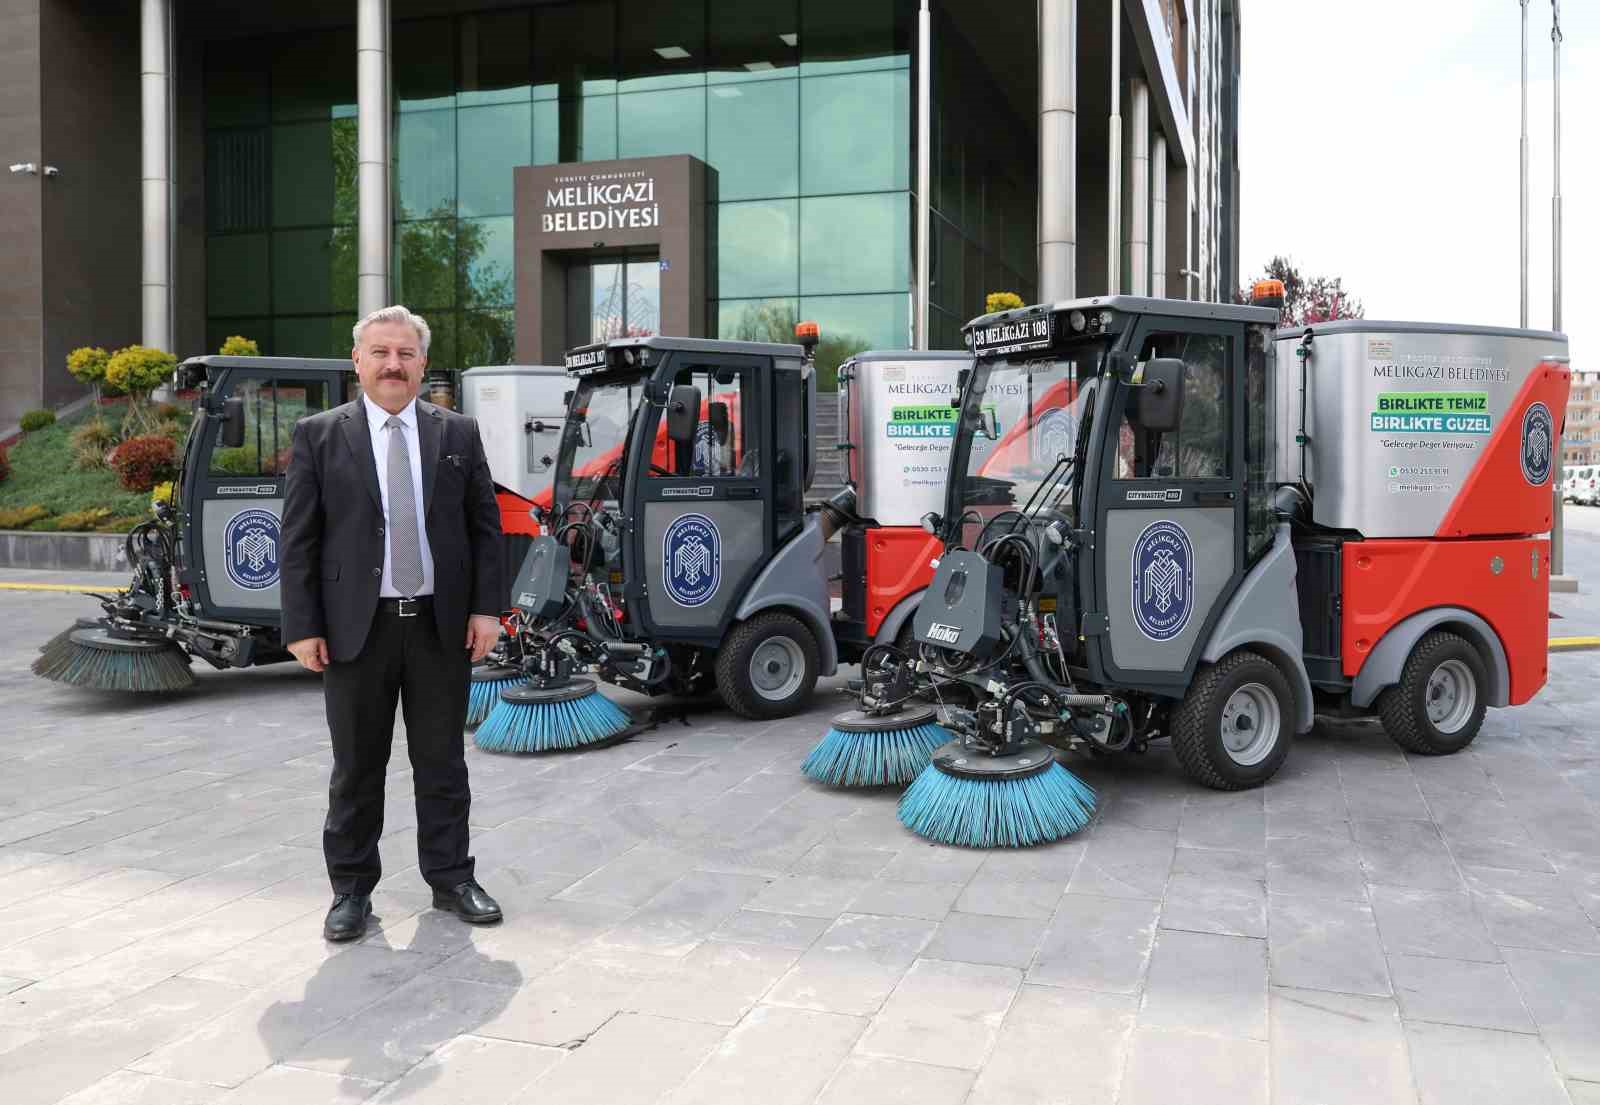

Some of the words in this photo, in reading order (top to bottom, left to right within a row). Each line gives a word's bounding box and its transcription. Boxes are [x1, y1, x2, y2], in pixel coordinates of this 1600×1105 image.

[545, 178, 654, 208] MELİKGAZİ
[541, 203, 659, 232] BELEDİYESİ
[975, 330, 984, 346] 38
[1031, 320, 1047, 337] 108
